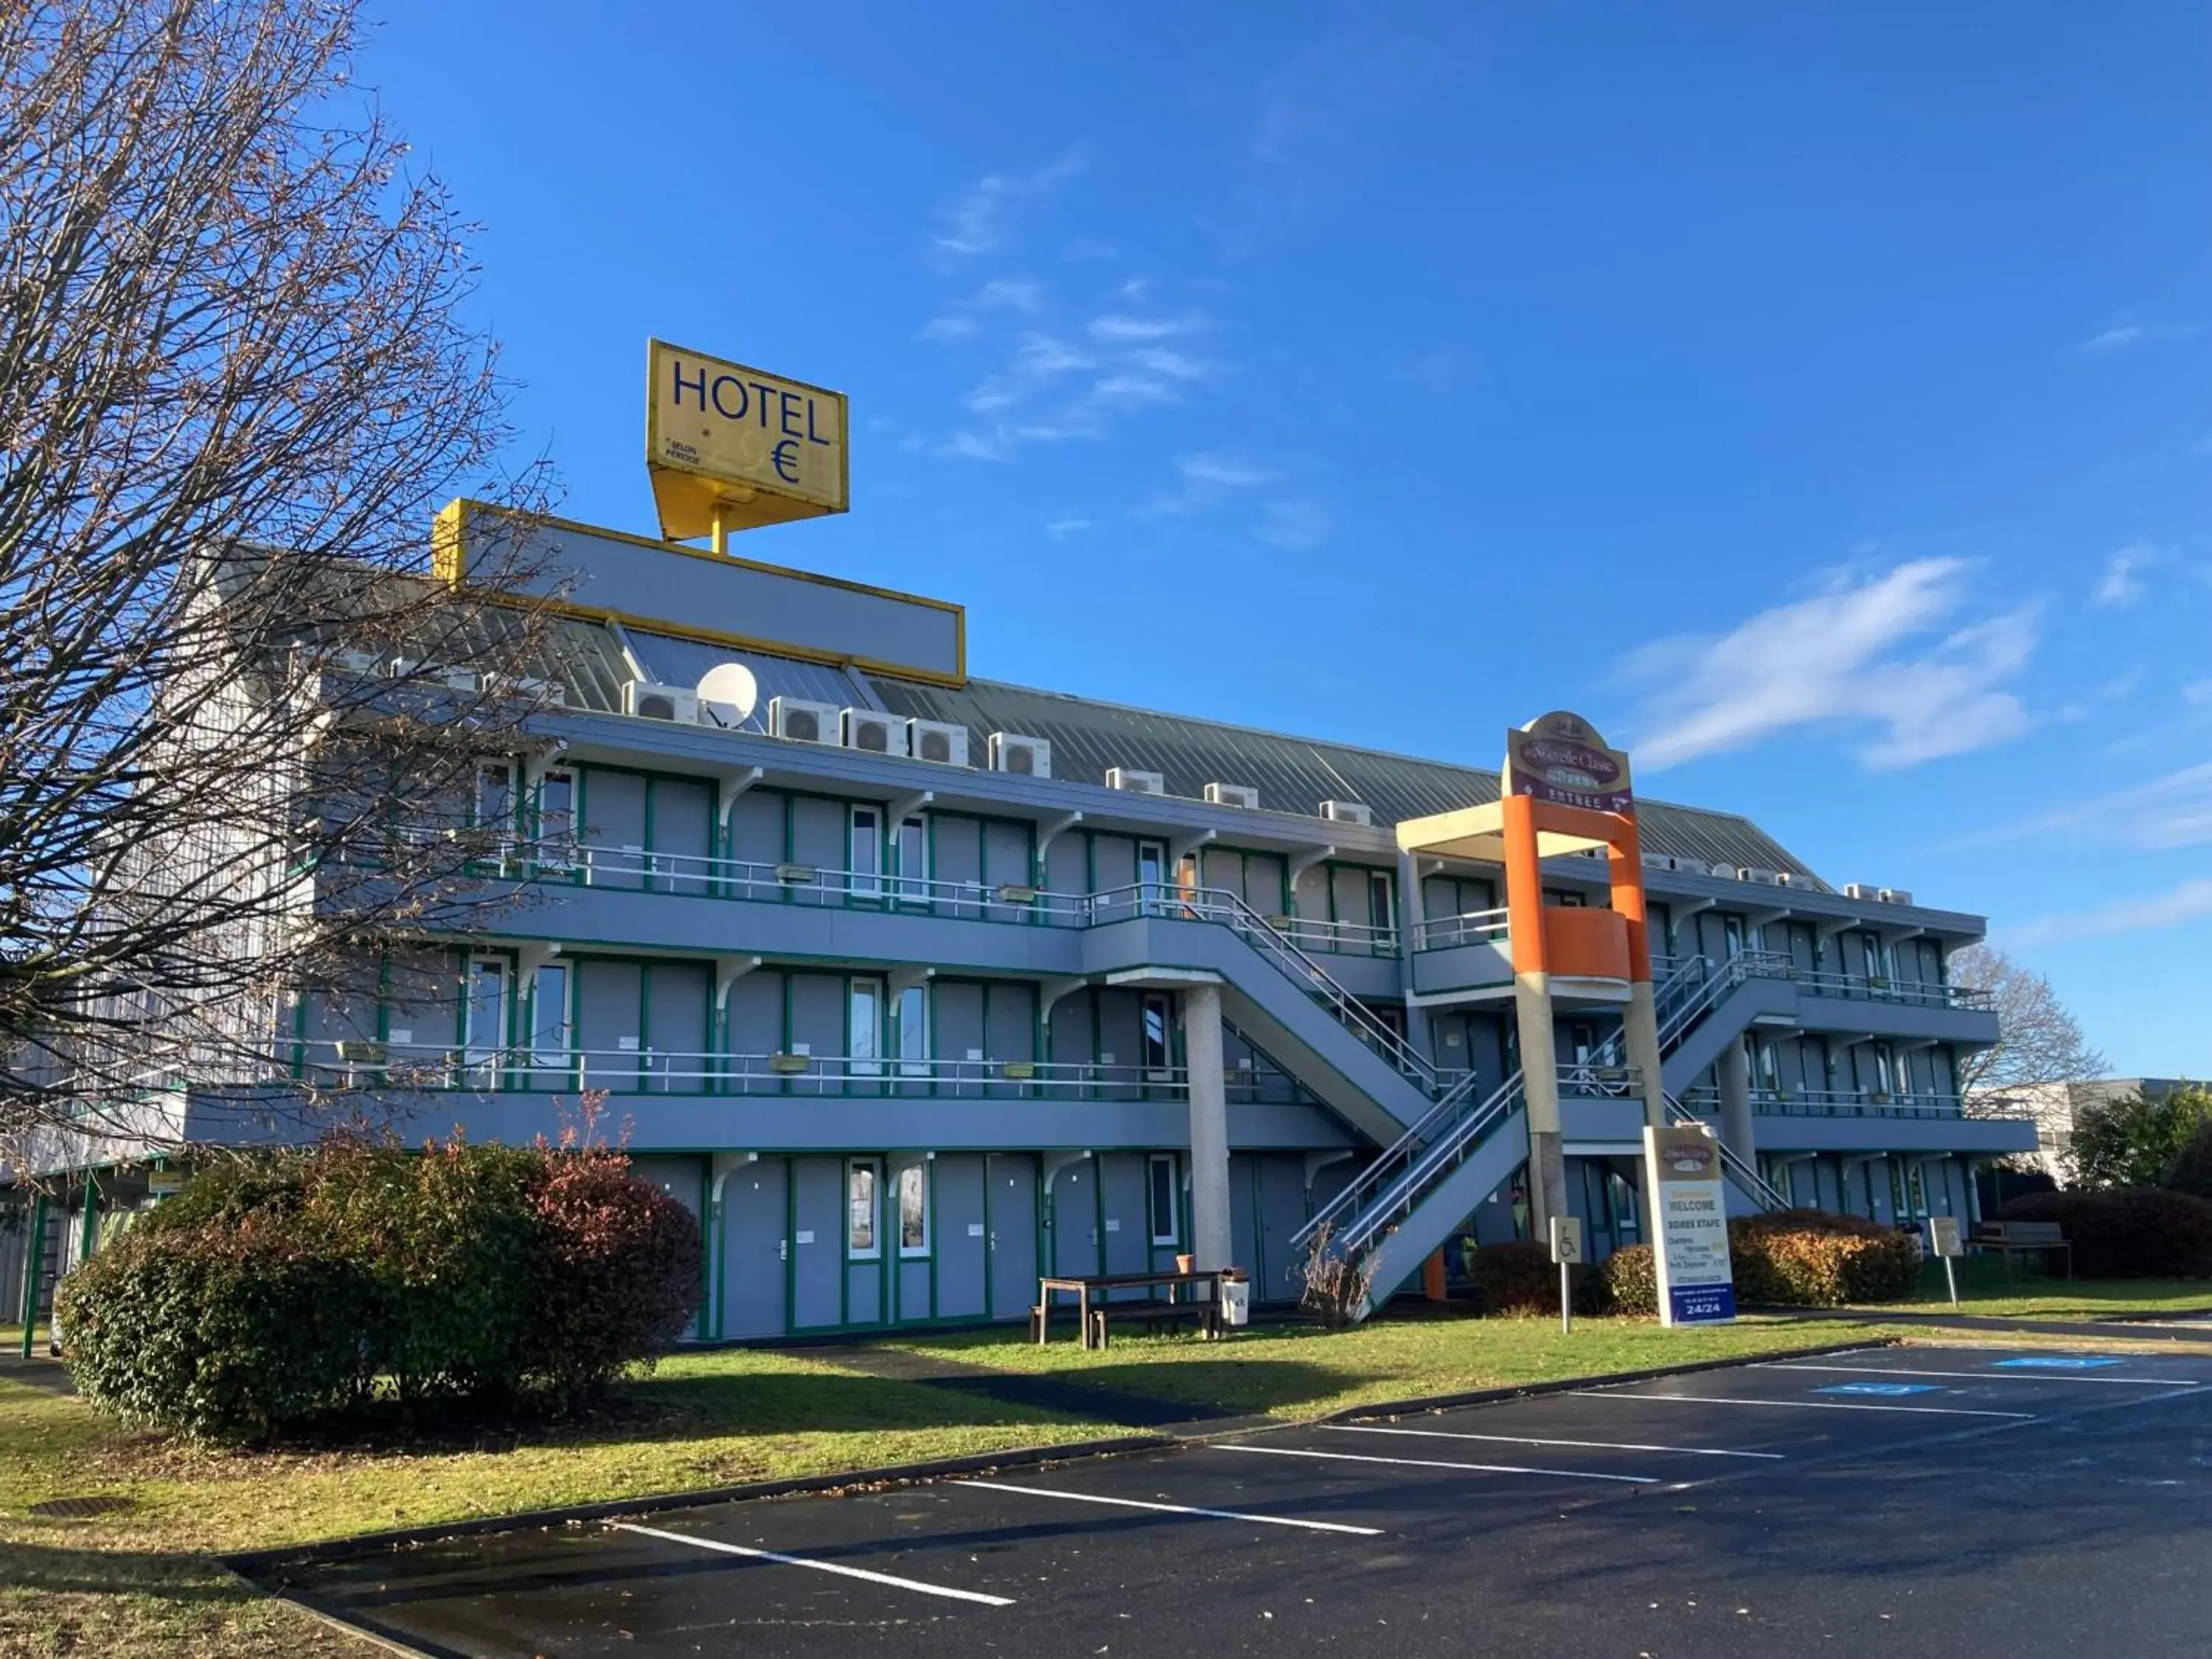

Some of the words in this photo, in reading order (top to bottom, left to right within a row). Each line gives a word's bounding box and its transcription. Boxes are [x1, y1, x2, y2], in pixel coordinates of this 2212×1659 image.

[675, 361, 830, 446] HOTEL
[771, 439, 799, 484] €
[1669, 1200, 1717, 1211] WELCOME
[1686, 1304, 1721, 1315] 24/24
